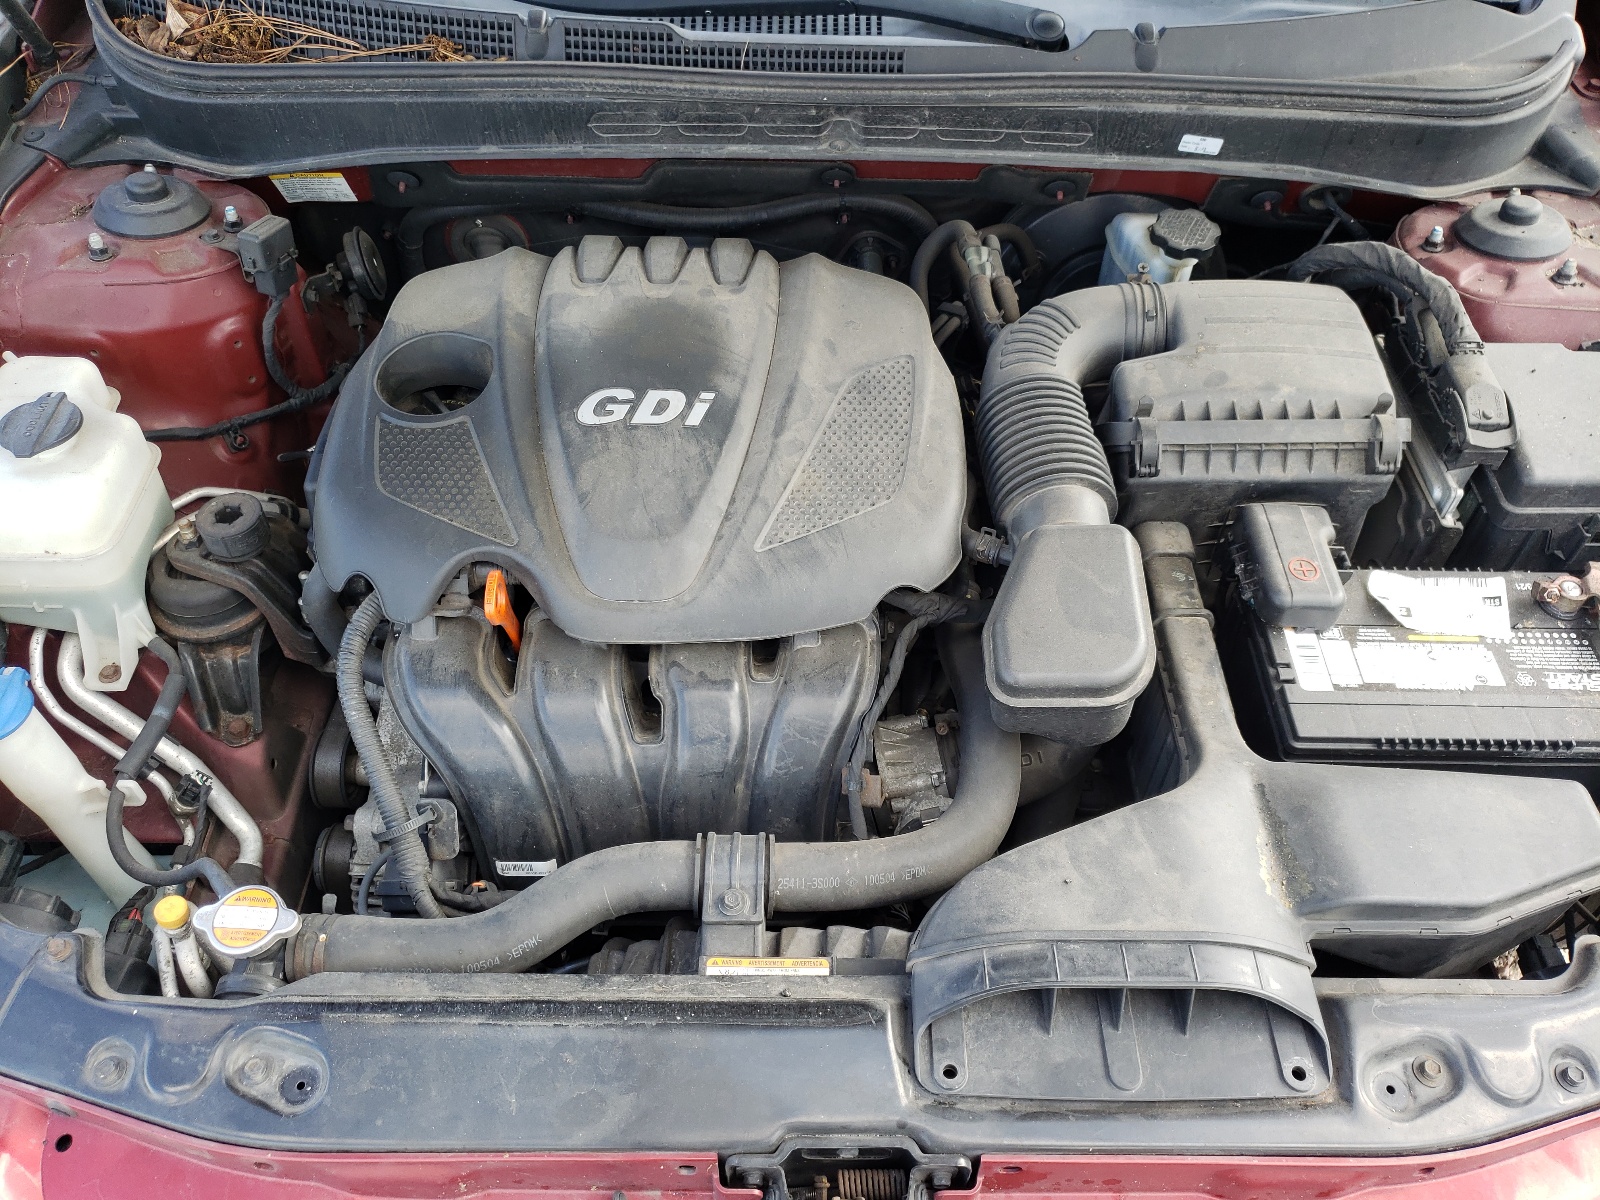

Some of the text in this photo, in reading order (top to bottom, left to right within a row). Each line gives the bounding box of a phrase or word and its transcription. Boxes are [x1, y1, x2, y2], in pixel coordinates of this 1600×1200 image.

[574, 386, 718, 428] GDi
[864, 871, 896, 887] 100504
[242, 896, 271, 904] WARNING
